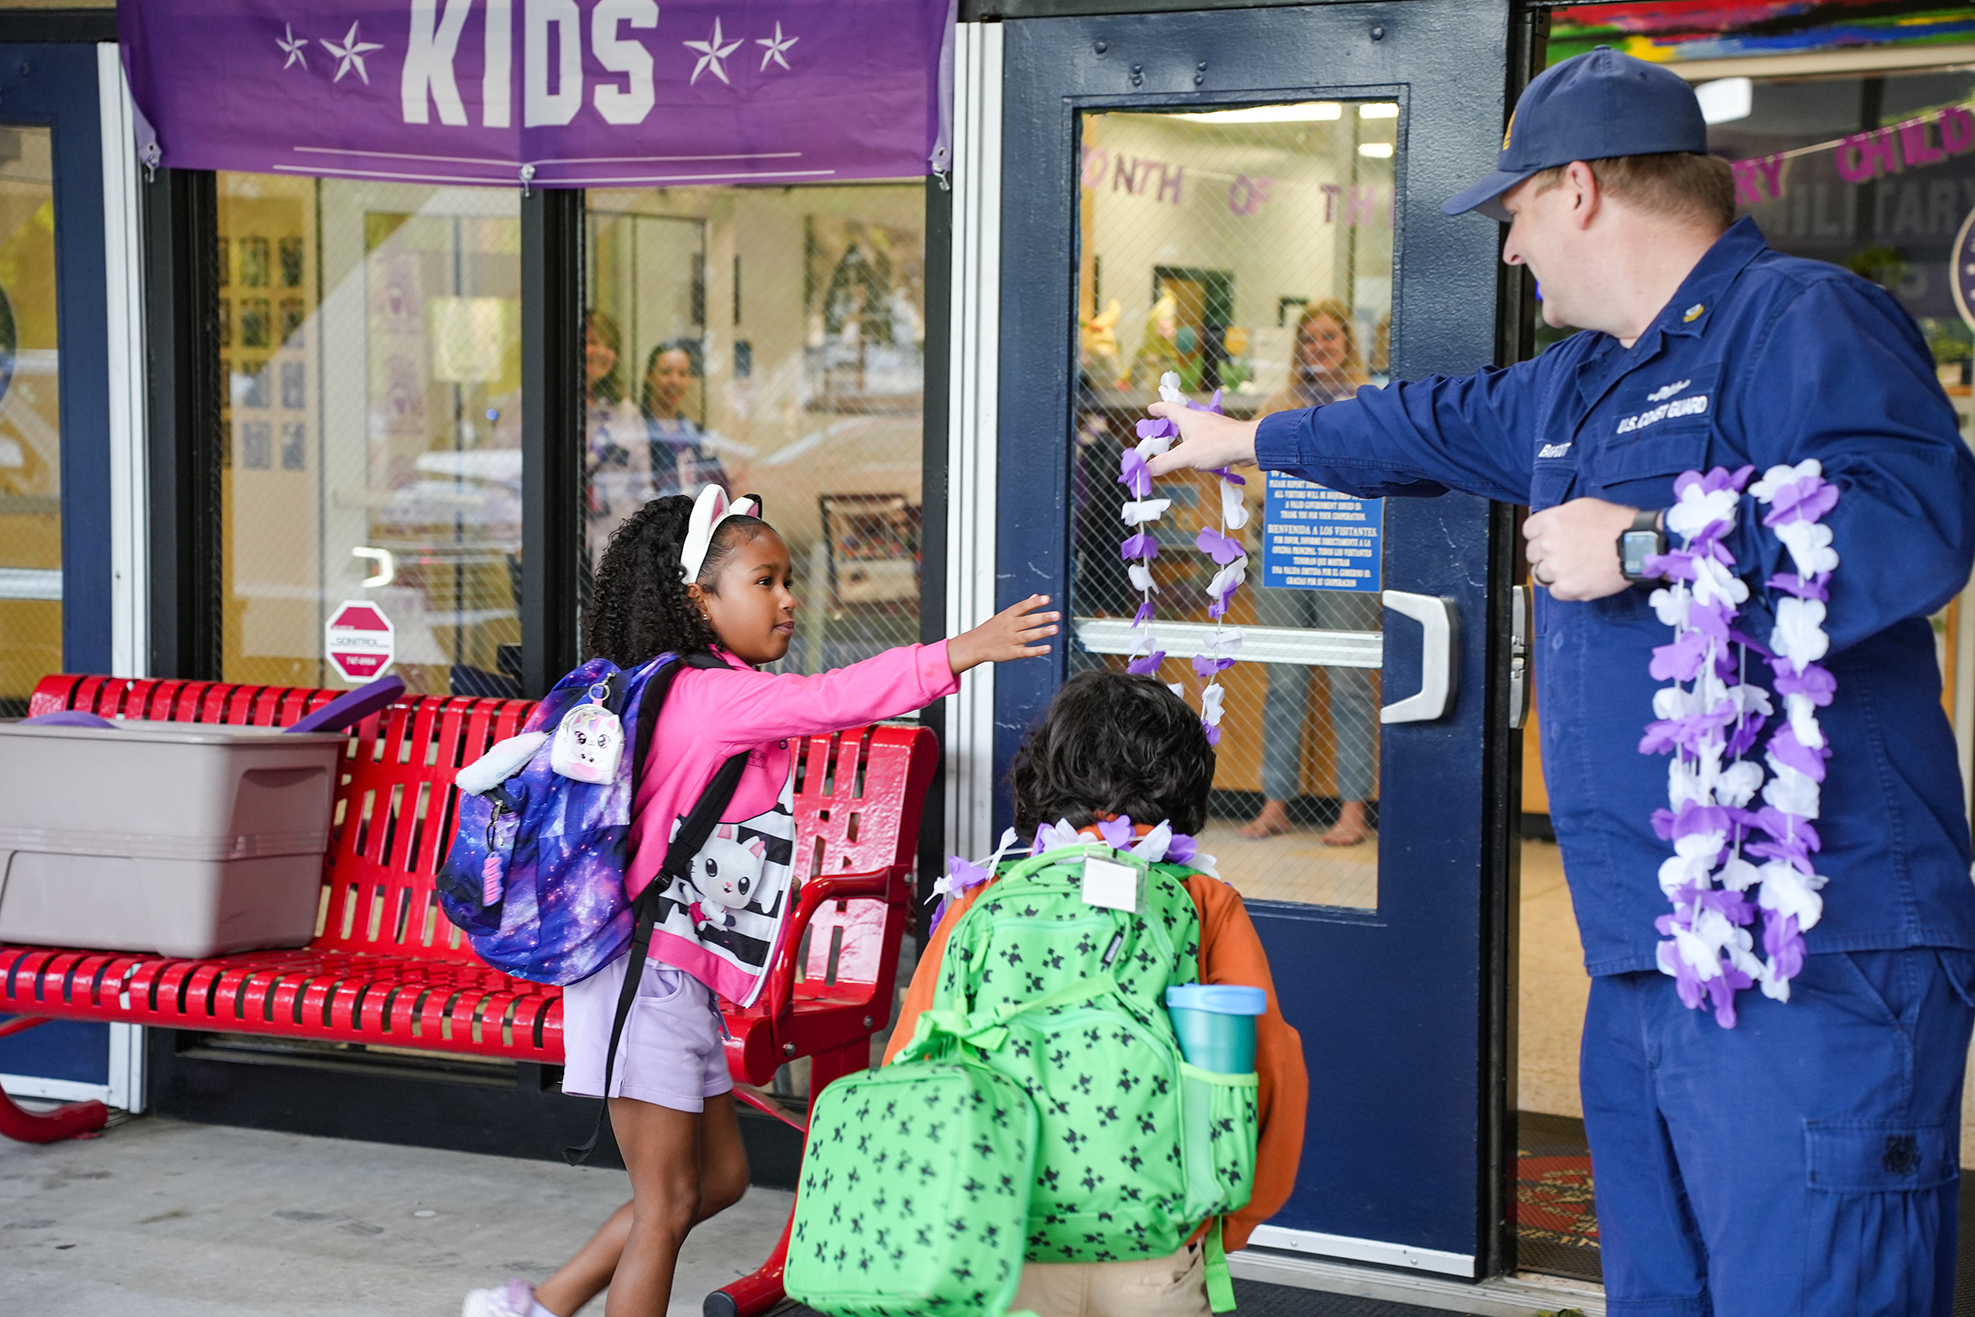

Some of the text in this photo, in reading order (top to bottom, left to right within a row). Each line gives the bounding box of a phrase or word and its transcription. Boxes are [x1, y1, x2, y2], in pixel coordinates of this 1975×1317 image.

[402, 0, 660, 127] KIDS
[1835, 108, 1974, 184] CHILD
[1081, 143, 1396, 229] ONTH OF TH
[1616, 395, 1709, 434] U.S. COAST GUARD
[1268, 524, 1310, 535] BIENVENIDA
[1312, 525, 1318, 535] A
[1320, 526, 1333, 535] LOS
[335, 636, 378, 647] SONITROL
